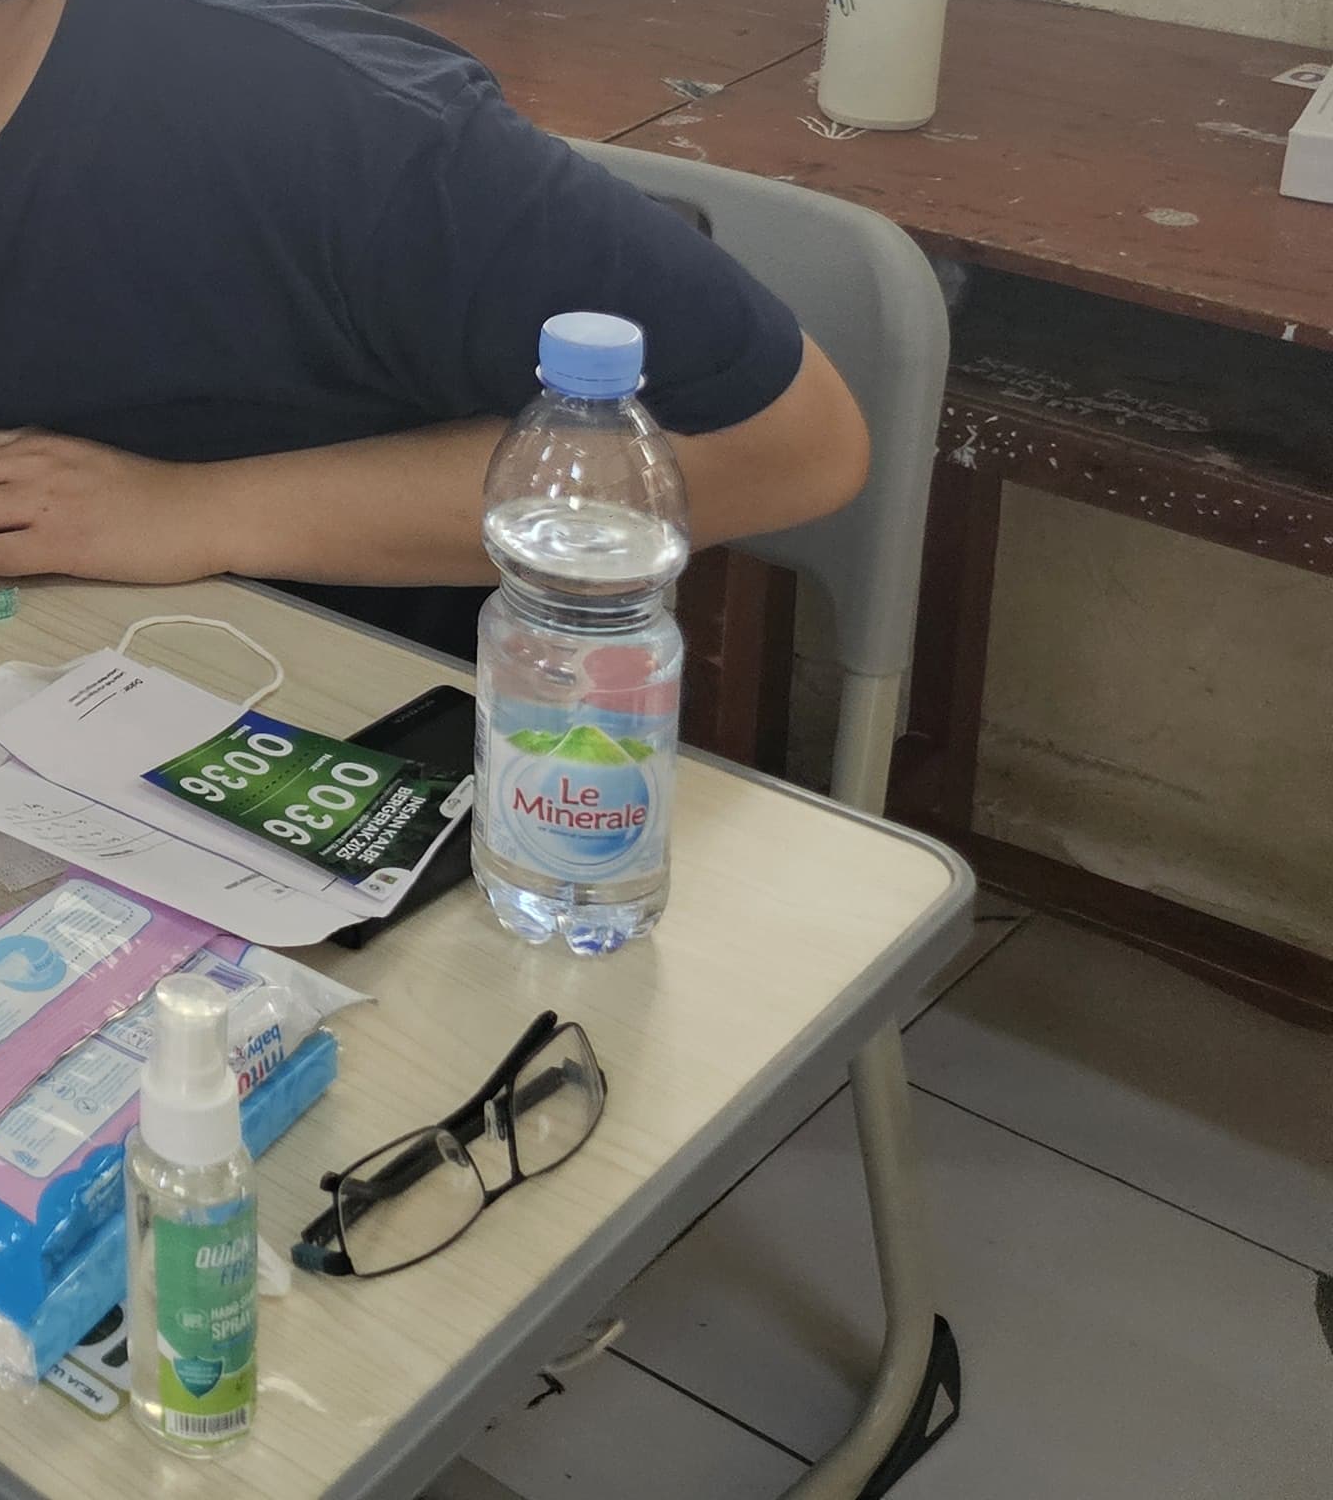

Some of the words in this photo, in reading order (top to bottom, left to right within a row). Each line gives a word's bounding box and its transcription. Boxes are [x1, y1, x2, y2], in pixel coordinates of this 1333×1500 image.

[179, 732, 294, 803] 0036
[262, 762, 380, 846] 0036
[359, 786, 415, 839] BERGERAK
[394, 795, 428, 831] INSAN
[512, 787, 647, 831] Minerale
[561, 777, 600, 807] Le
[335, 830, 362, 861] 2025
[357, 822, 399, 865] KALBE
[246, 1023, 282, 1060] baby
